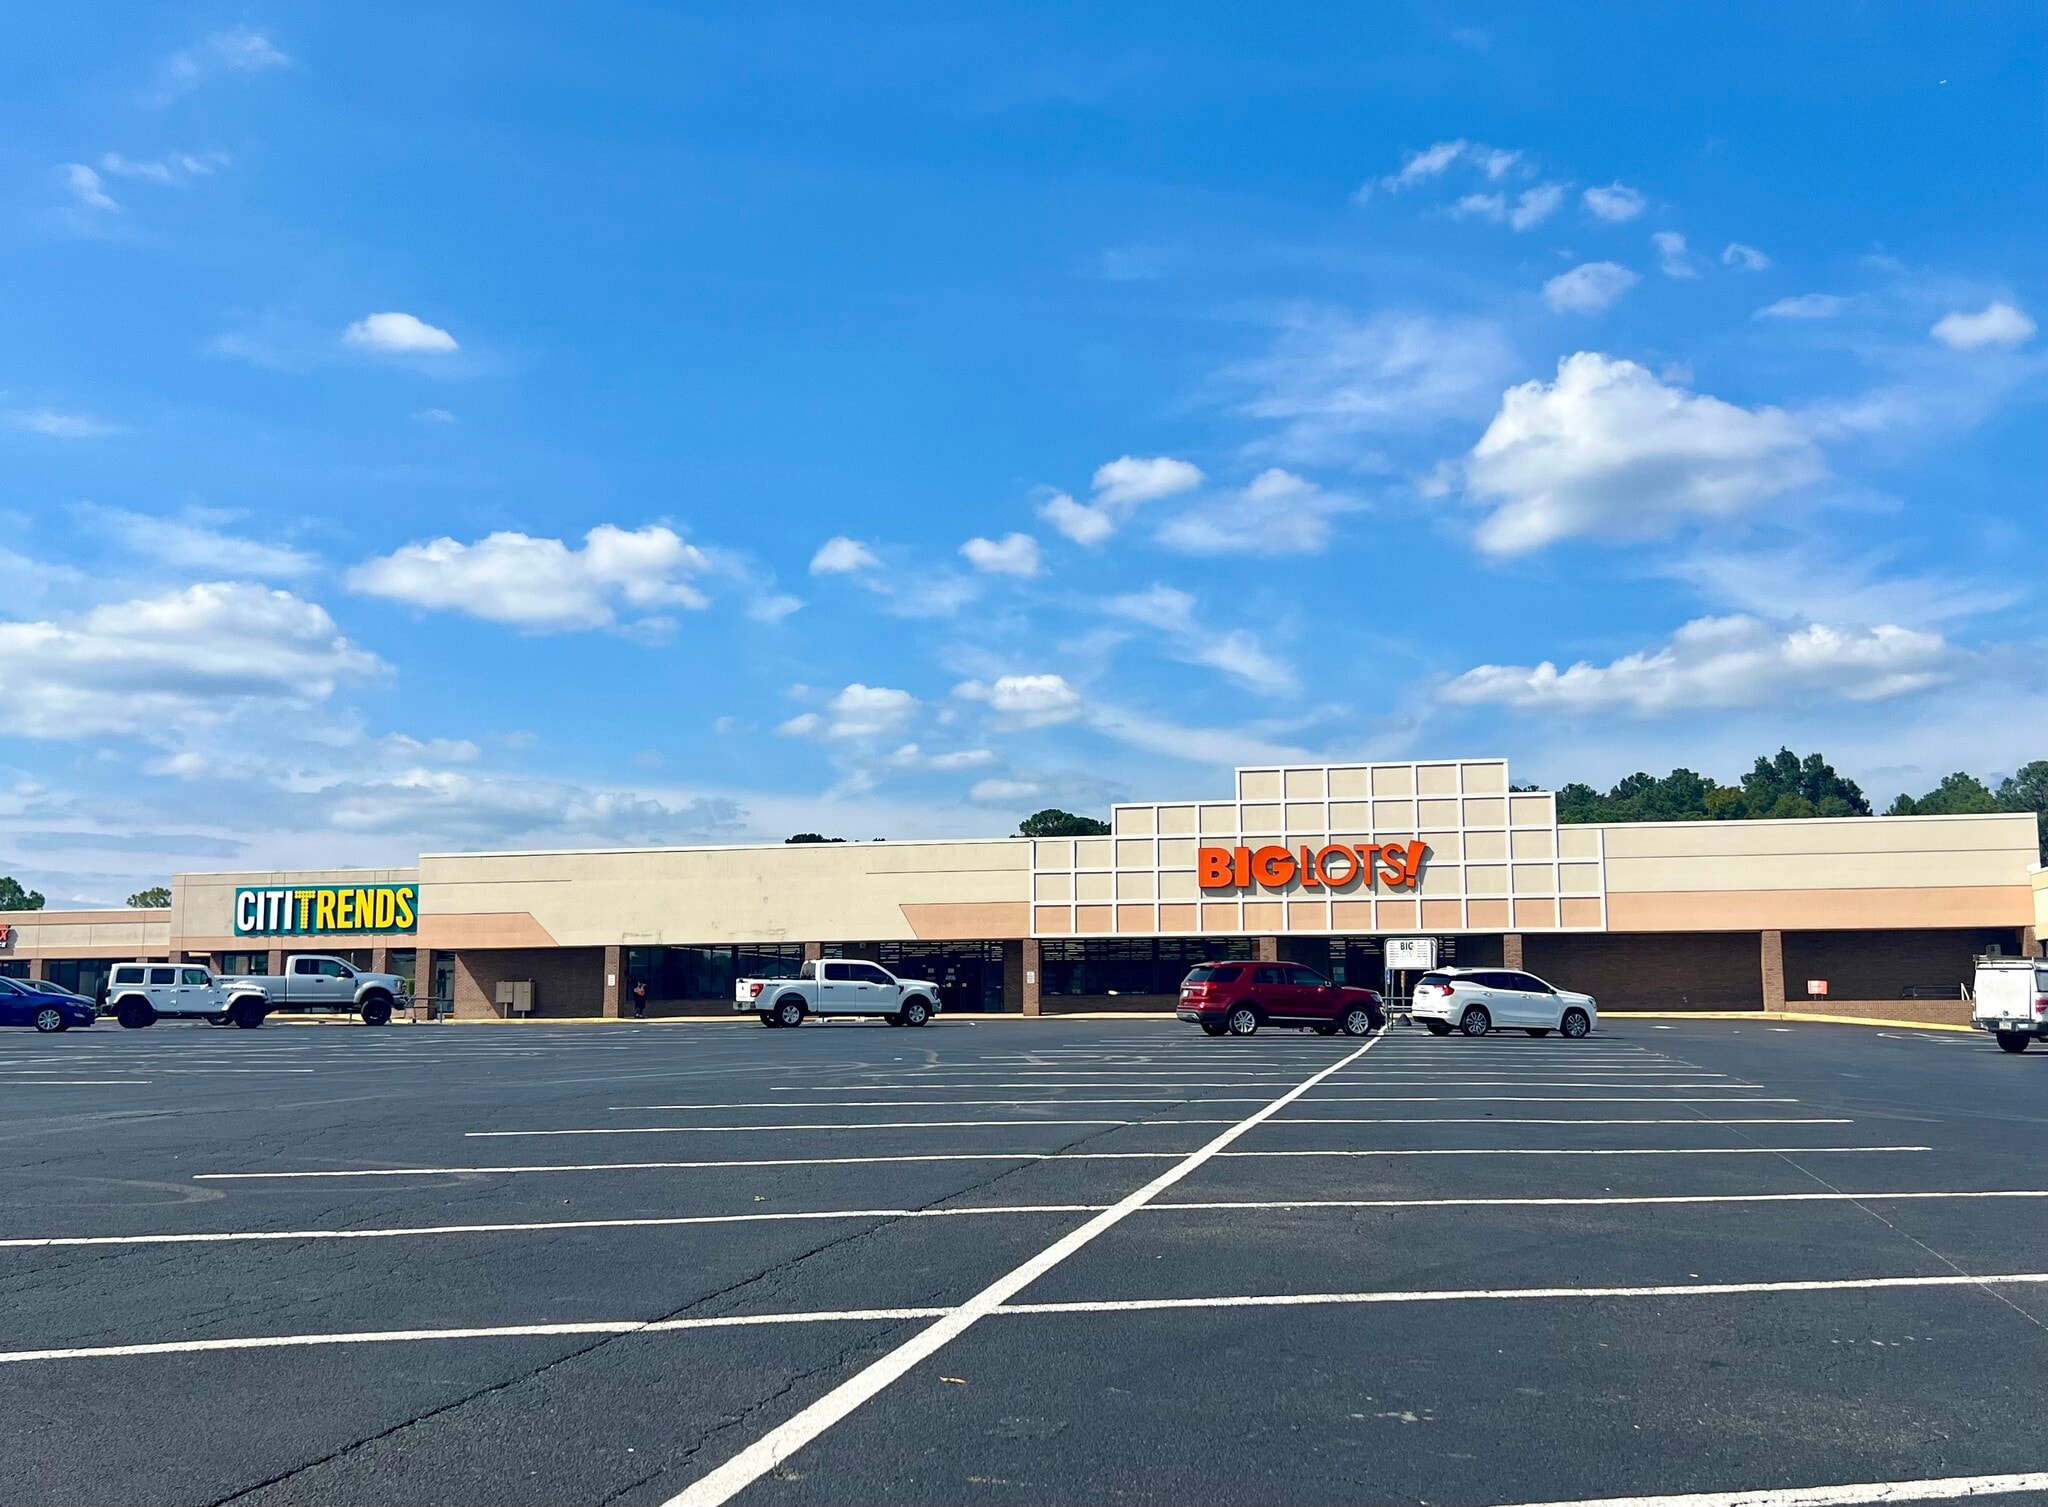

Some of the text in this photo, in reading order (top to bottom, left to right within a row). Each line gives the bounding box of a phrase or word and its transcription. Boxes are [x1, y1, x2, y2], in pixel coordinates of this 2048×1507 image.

[1198, 839, 1427, 887] BIG LOTS!
[1400, 941, 1414, 951] BIG
